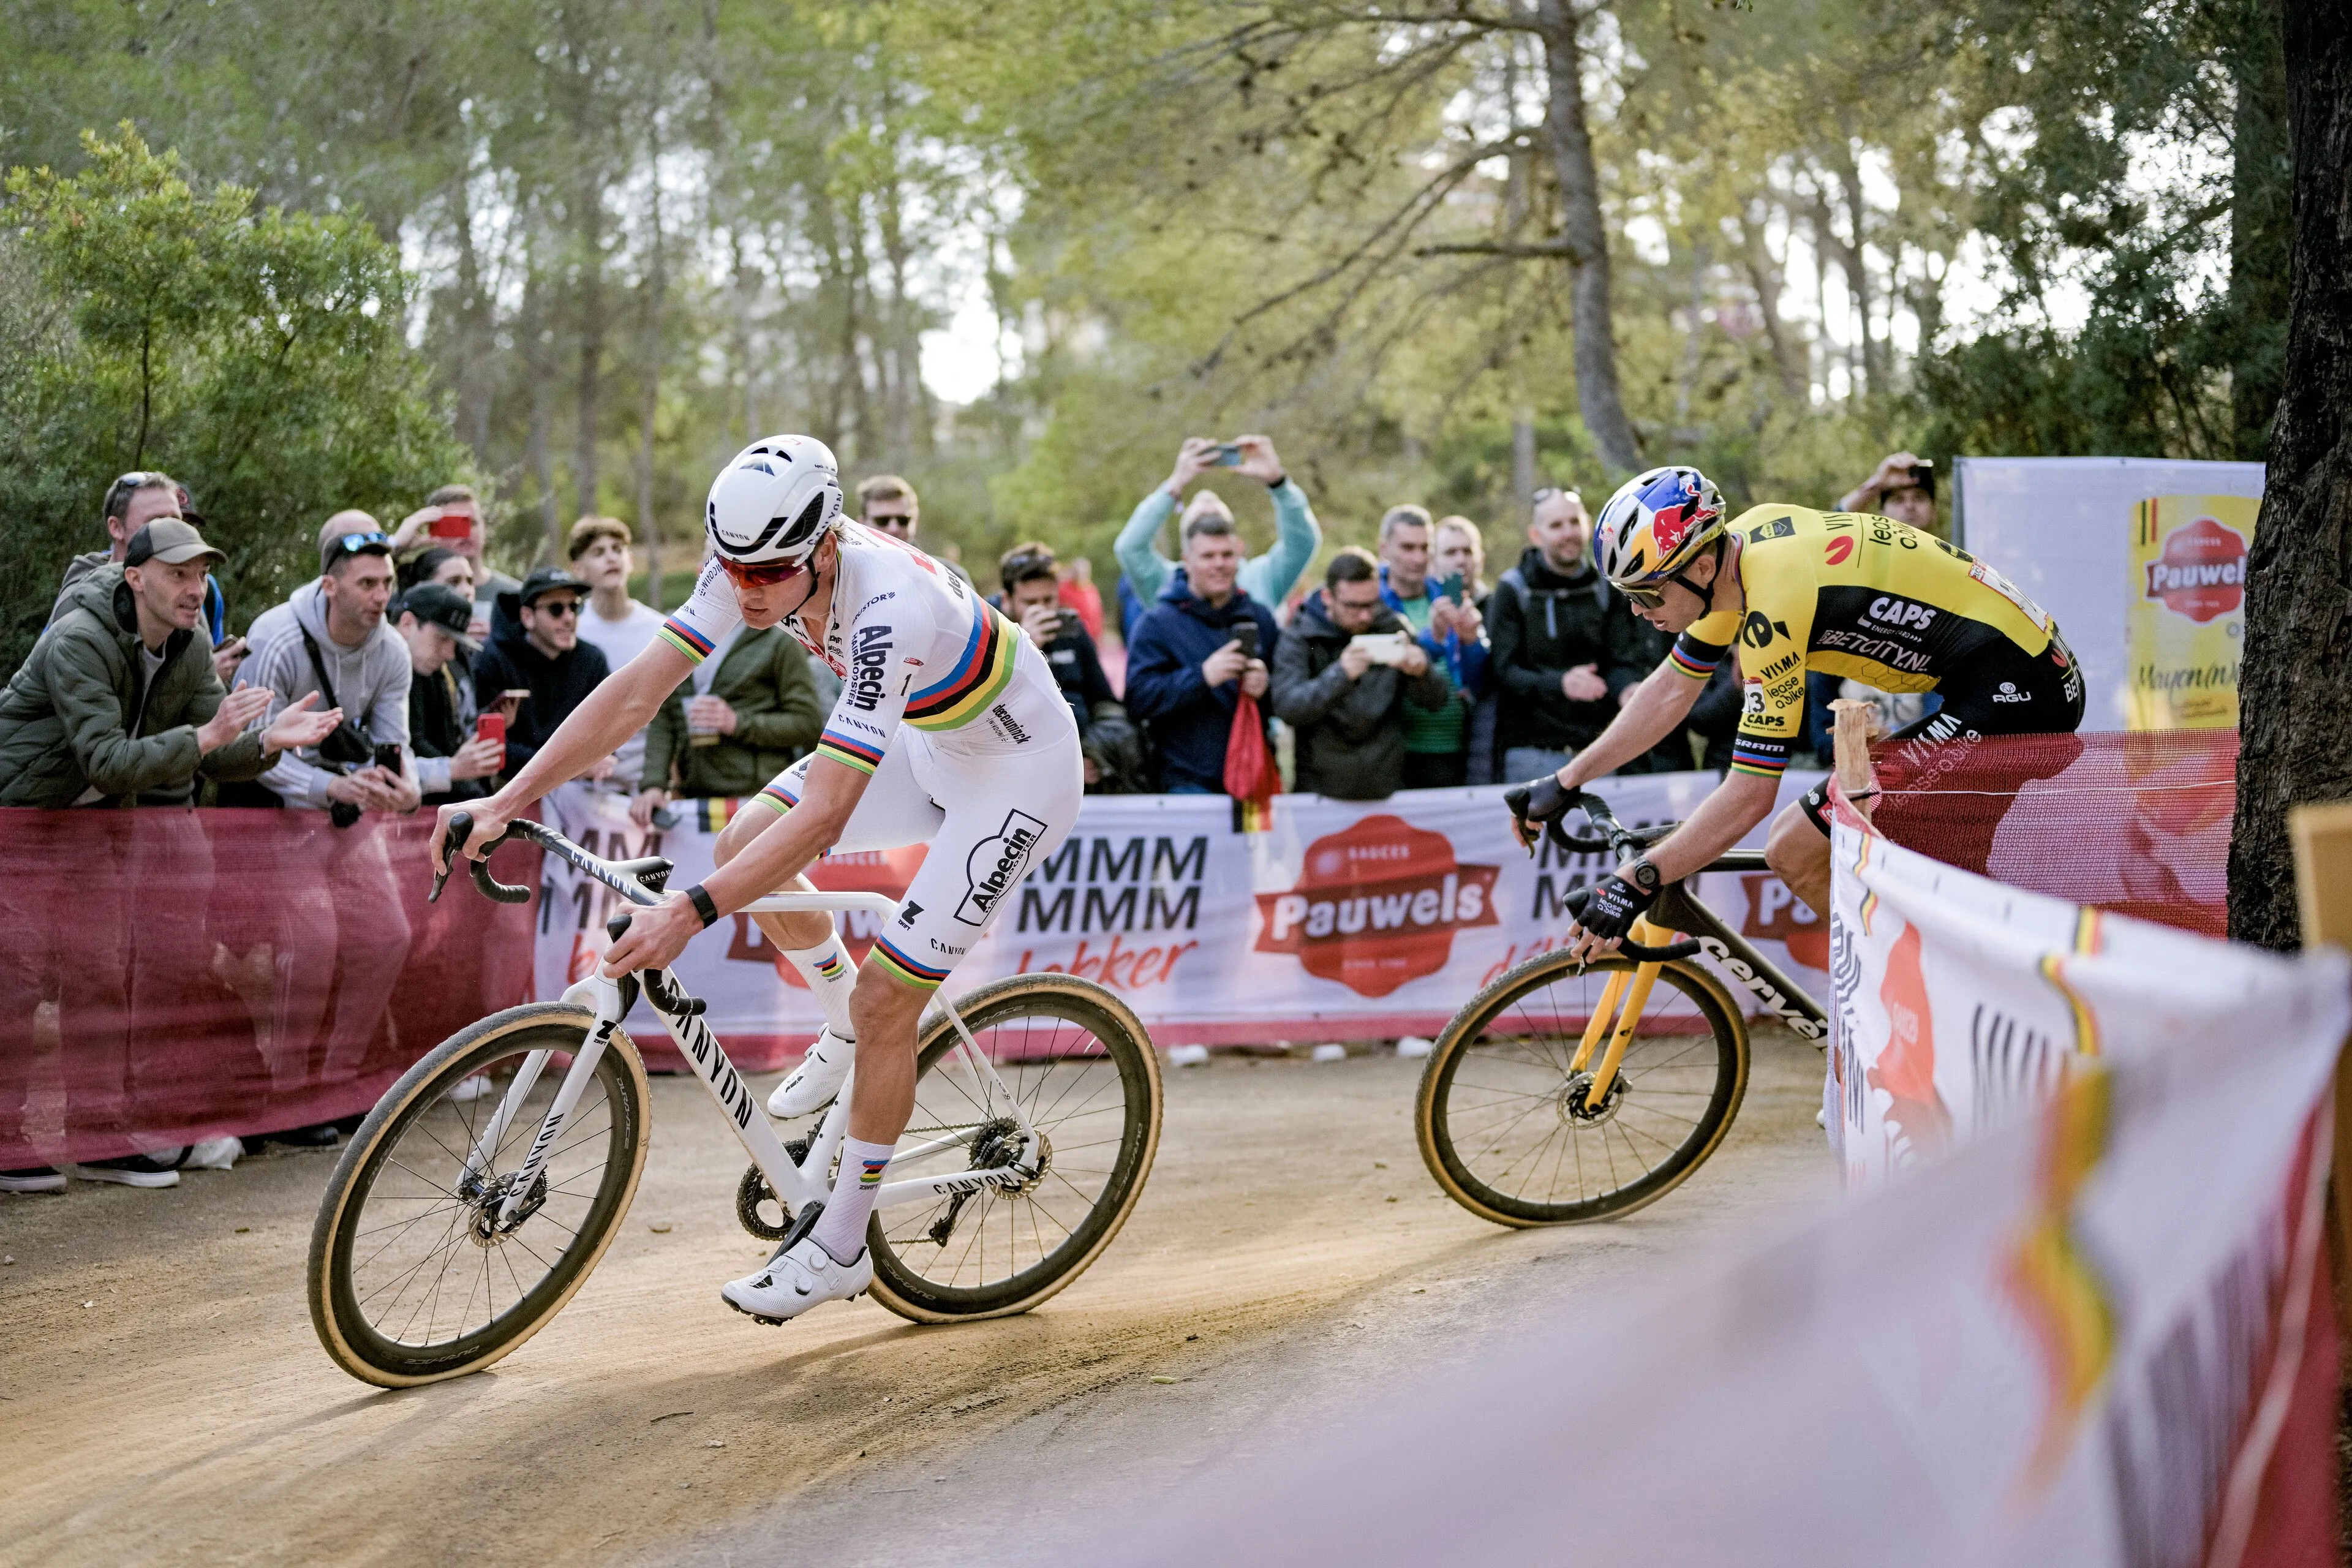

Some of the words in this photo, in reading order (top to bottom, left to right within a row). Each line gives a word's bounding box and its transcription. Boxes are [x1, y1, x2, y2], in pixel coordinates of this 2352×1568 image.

[722, 530, 750, 541] CANYON
[2152, 555, 2247, 592] Pauwel
[1869, 597, 1937, 630] CAPS
[1871, 625, 1896, 636] ENERGY
[854, 625, 893, 712] Alpecin
[1760, 651, 1801, 680] VISMA
[900, 673, 912, 696] 1
[1766, 677, 1799, 699] lease
[1992, 692, 2032, 703] AGU
[838, 714, 886, 738] CANYON
[1747, 714, 1785, 727] CAPS
[1898, 713, 1962, 766] VISMA
[571, 850, 632, 896] CANYON
[639, 869, 671, 883] CANYON
[971, 827, 1032, 913] Alpecin
[1272, 873, 1483, 941] Pauwels
[1608, 892, 1634, 909] VISMA
[898, 919, 911, 931] ZWIFT
[930, 938, 967, 956] CANYON
[826, 969, 848, 983] ZWIFT
[509, 1112, 565, 1198] CANYON
[933, 1173, 1014, 1194] CANYON
